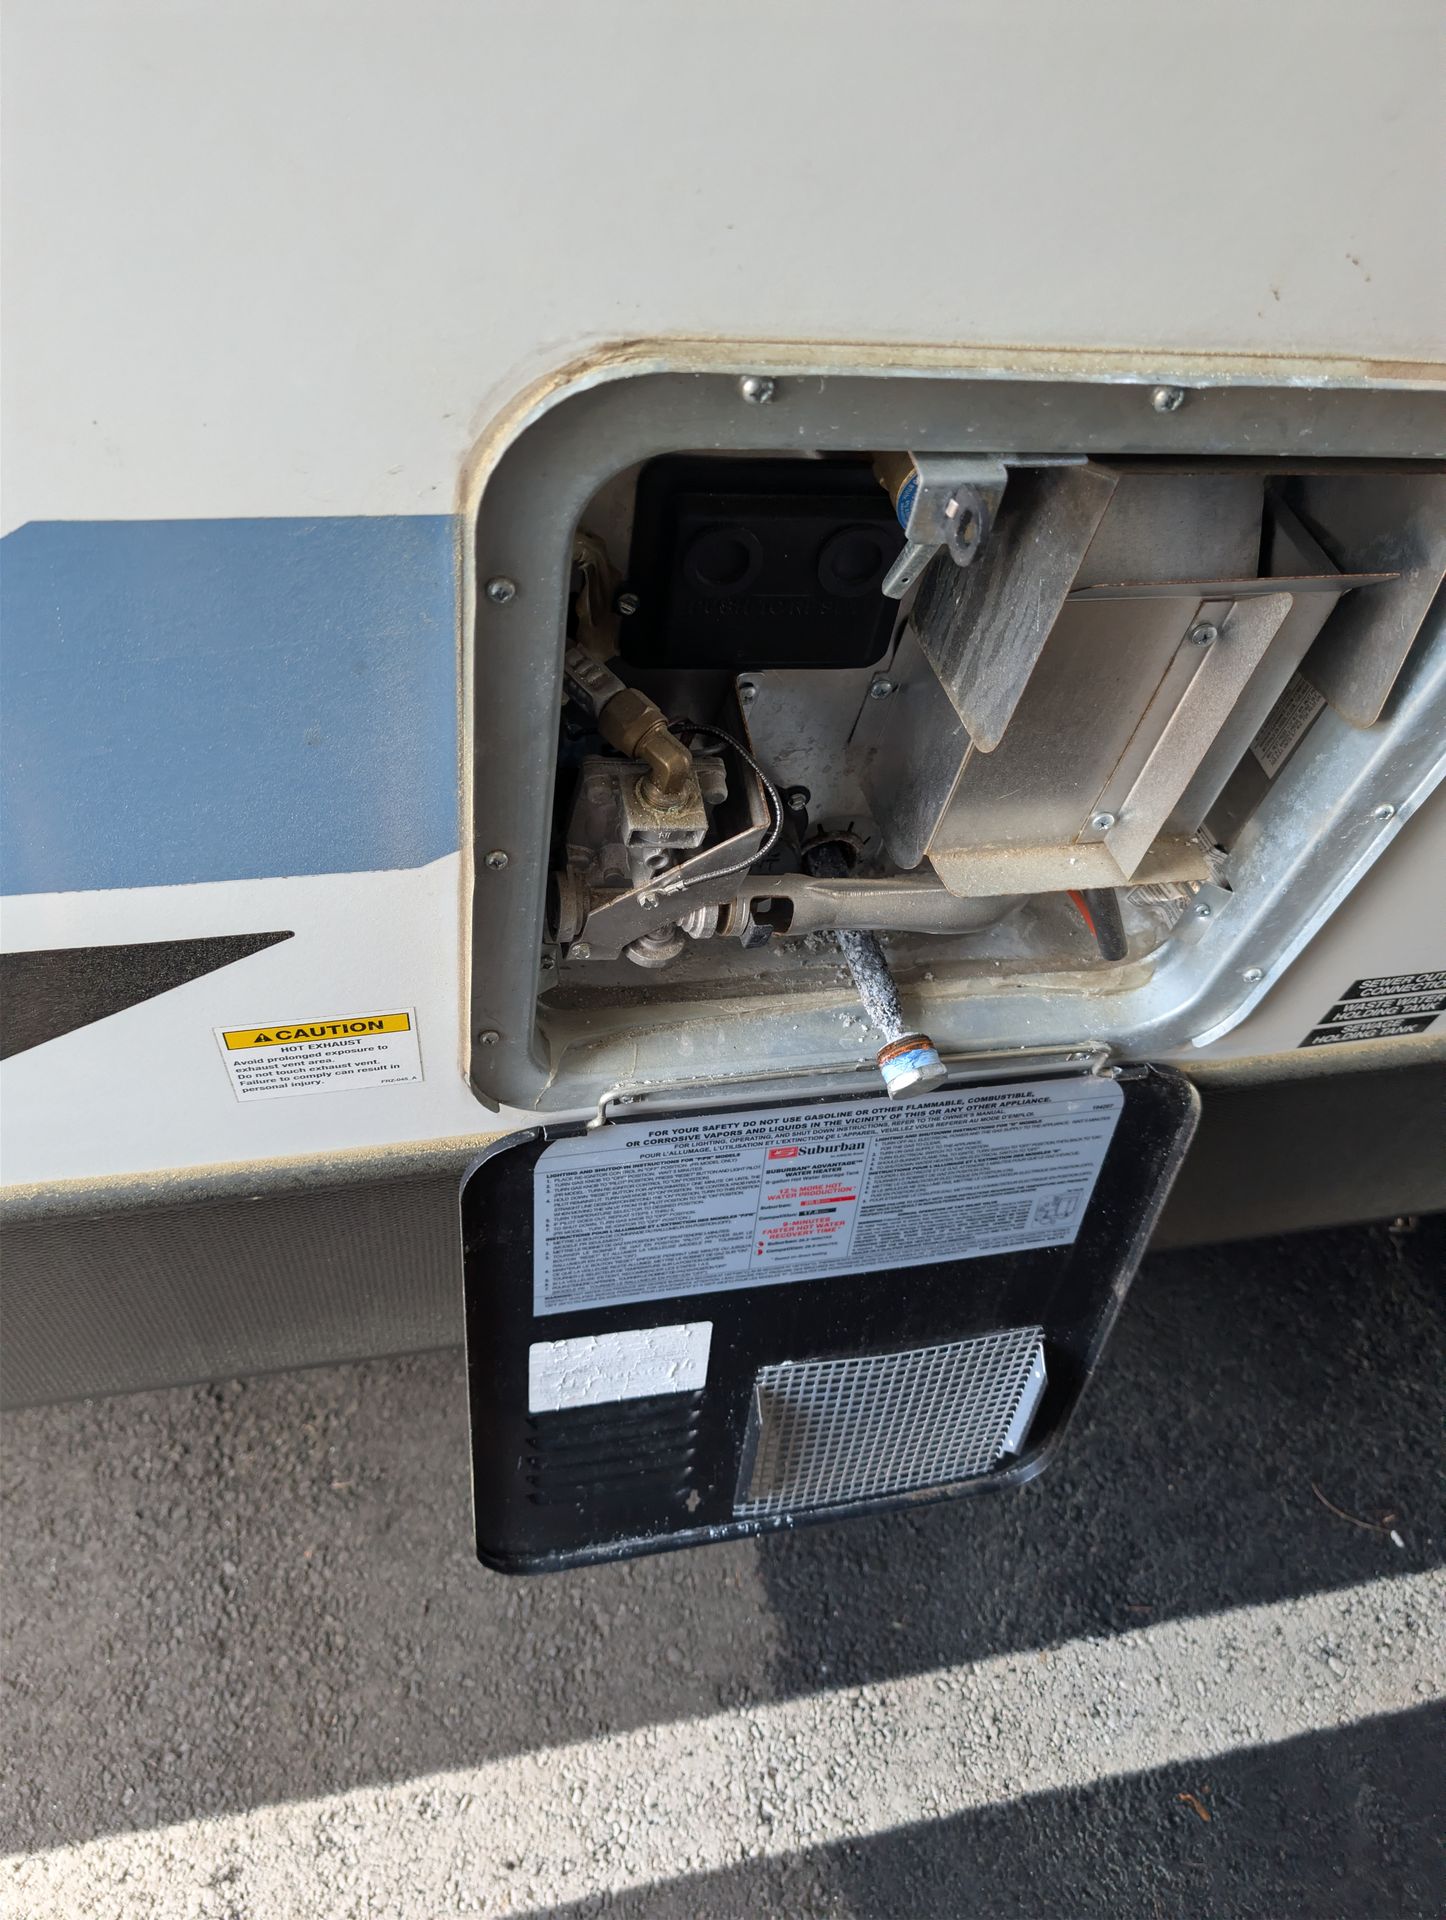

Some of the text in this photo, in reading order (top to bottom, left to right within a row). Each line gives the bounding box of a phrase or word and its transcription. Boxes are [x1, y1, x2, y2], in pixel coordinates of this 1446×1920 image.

[1360, 976, 1415, 989] SEWER
[1333, 1002, 1440, 1021] HOLDING TANK
[1344, 995, 1446, 1012] WASTE WATER
[276, 1020, 384, 1040] CAUTION
[1312, 1024, 1418, 1044] HOLDING TANK
[1341, 1019, 1405, 1034] SEWAGE
[309, 1039, 362, 1050] EXHAUST
[268, 1052, 321, 1063] prolonged
[325, 1046, 374, 1056] exposure
[236, 1064, 278, 1072] exhaust
[240, 1078, 276, 1086] Failure
[358, 1065, 387, 1073] result
[309, 1063, 351, 1071] exhaust
[242, 1083, 288, 1093] personal
[703, 1123, 740, 1131] SAFETY
[759, 1118, 779, 1126] NOT
[804, 1111, 853, 1121] GASOLINE
[872, 1106, 903, 1114] OTHER
[906, 1099, 965, 1110] FLAMMABLE,
[968, 1092, 1035, 1104] COMBUSTIBLE,
[644, 1134, 700, 1146] CORROSIVE
[704, 1130, 742, 1139] VAPORS
[769, 1124, 807, 1132] LIQUIDS
[845, 1115, 887, 1124] VICINITY
[966, 1103, 997, 1111] OTHER
[999, 1097, 1052, 1107] APPLIANCE.
[691, 1139, 727, 1147] LIGHTING,
[731, 1134, 772, 1143] OPERATING,
[943, 1112, 975, 1120] OWNER'S
[663, 1147, 711, 1156] L'ALLUMAGE,
[713, 1142, 763, 1151] L'UTILISATION
[776, 1135, 823, 1144] L'EXTINCTION
[880, 1125, 913, 1133] VEUILLEZ
[798, 1141, 865, 1156] Suburban
[816, 1220, 845, 1228] WATER
[769, 1230, 813, 1239] RECOVERY
